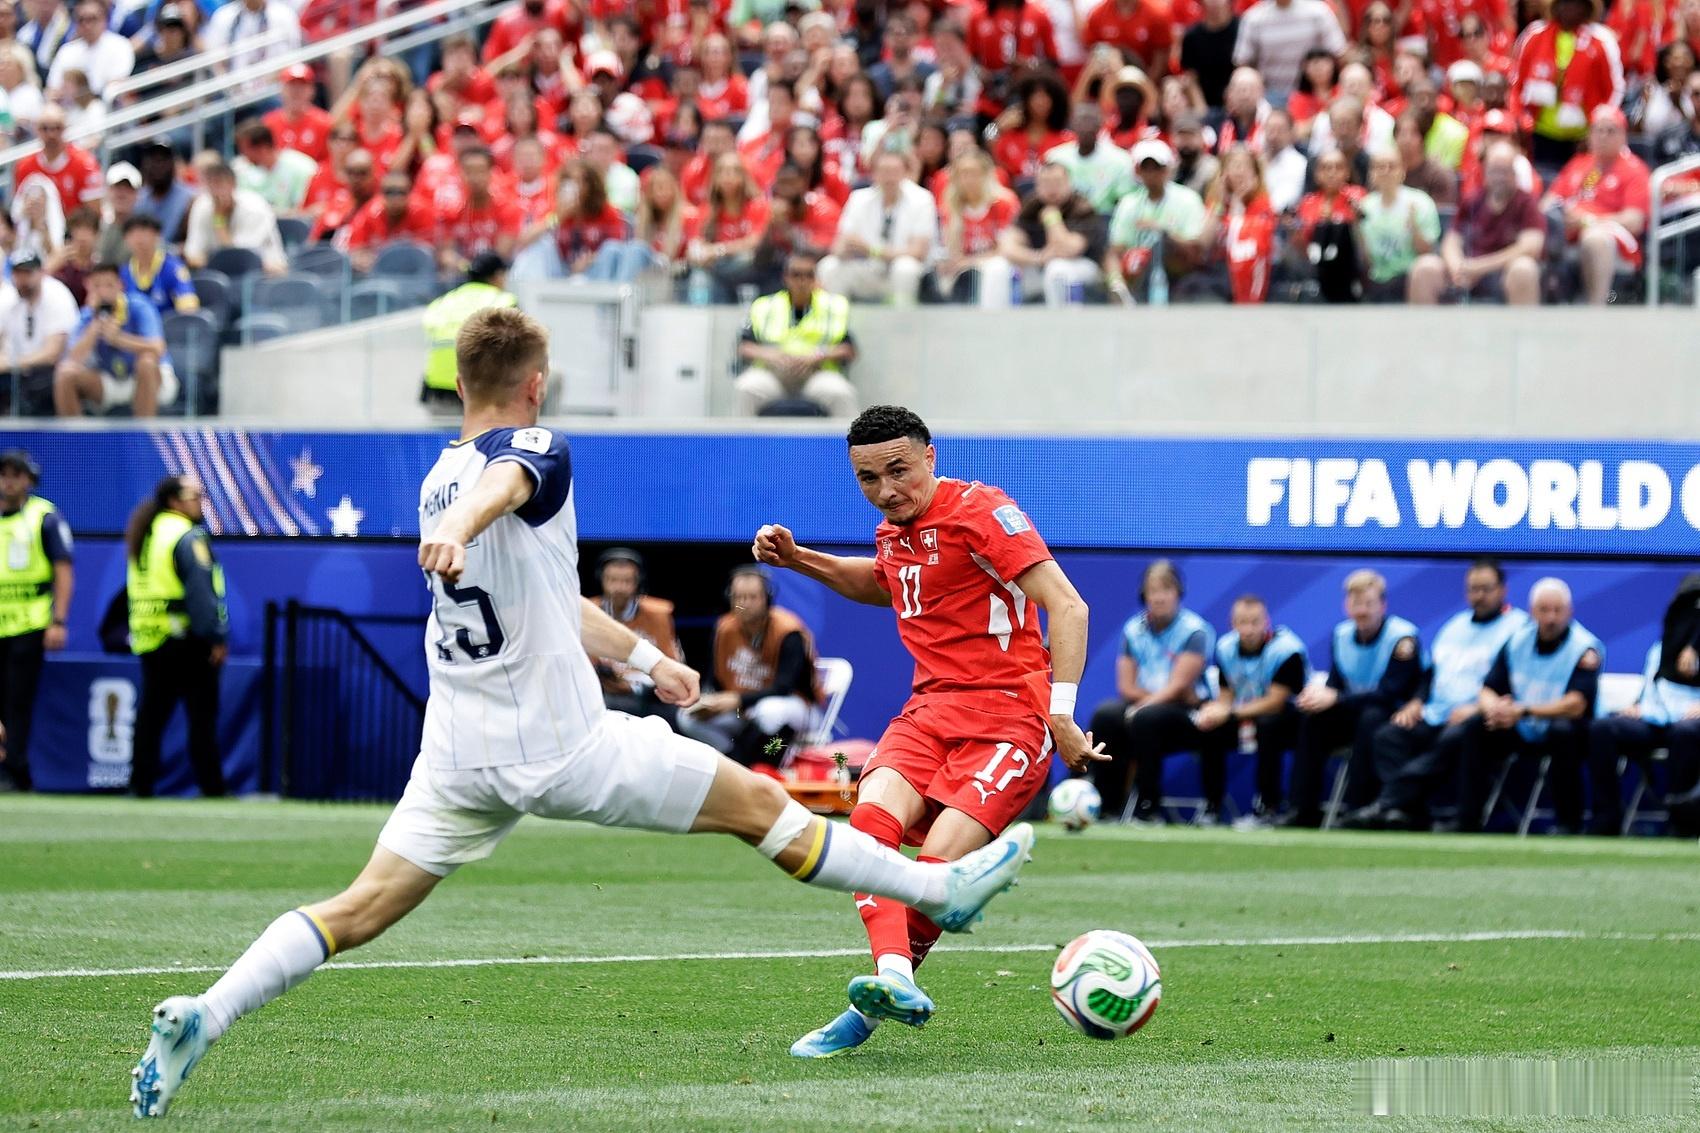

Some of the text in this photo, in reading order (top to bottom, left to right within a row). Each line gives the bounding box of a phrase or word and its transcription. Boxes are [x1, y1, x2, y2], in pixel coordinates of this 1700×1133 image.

[1247, 458, 1400, 527] FIFA
[1407, 459, 1672, 530] WORLD
[429, 552, 508, 663] 5
[898, 564, 922, 619] 17
[974, 742, 1030, 792] 17
